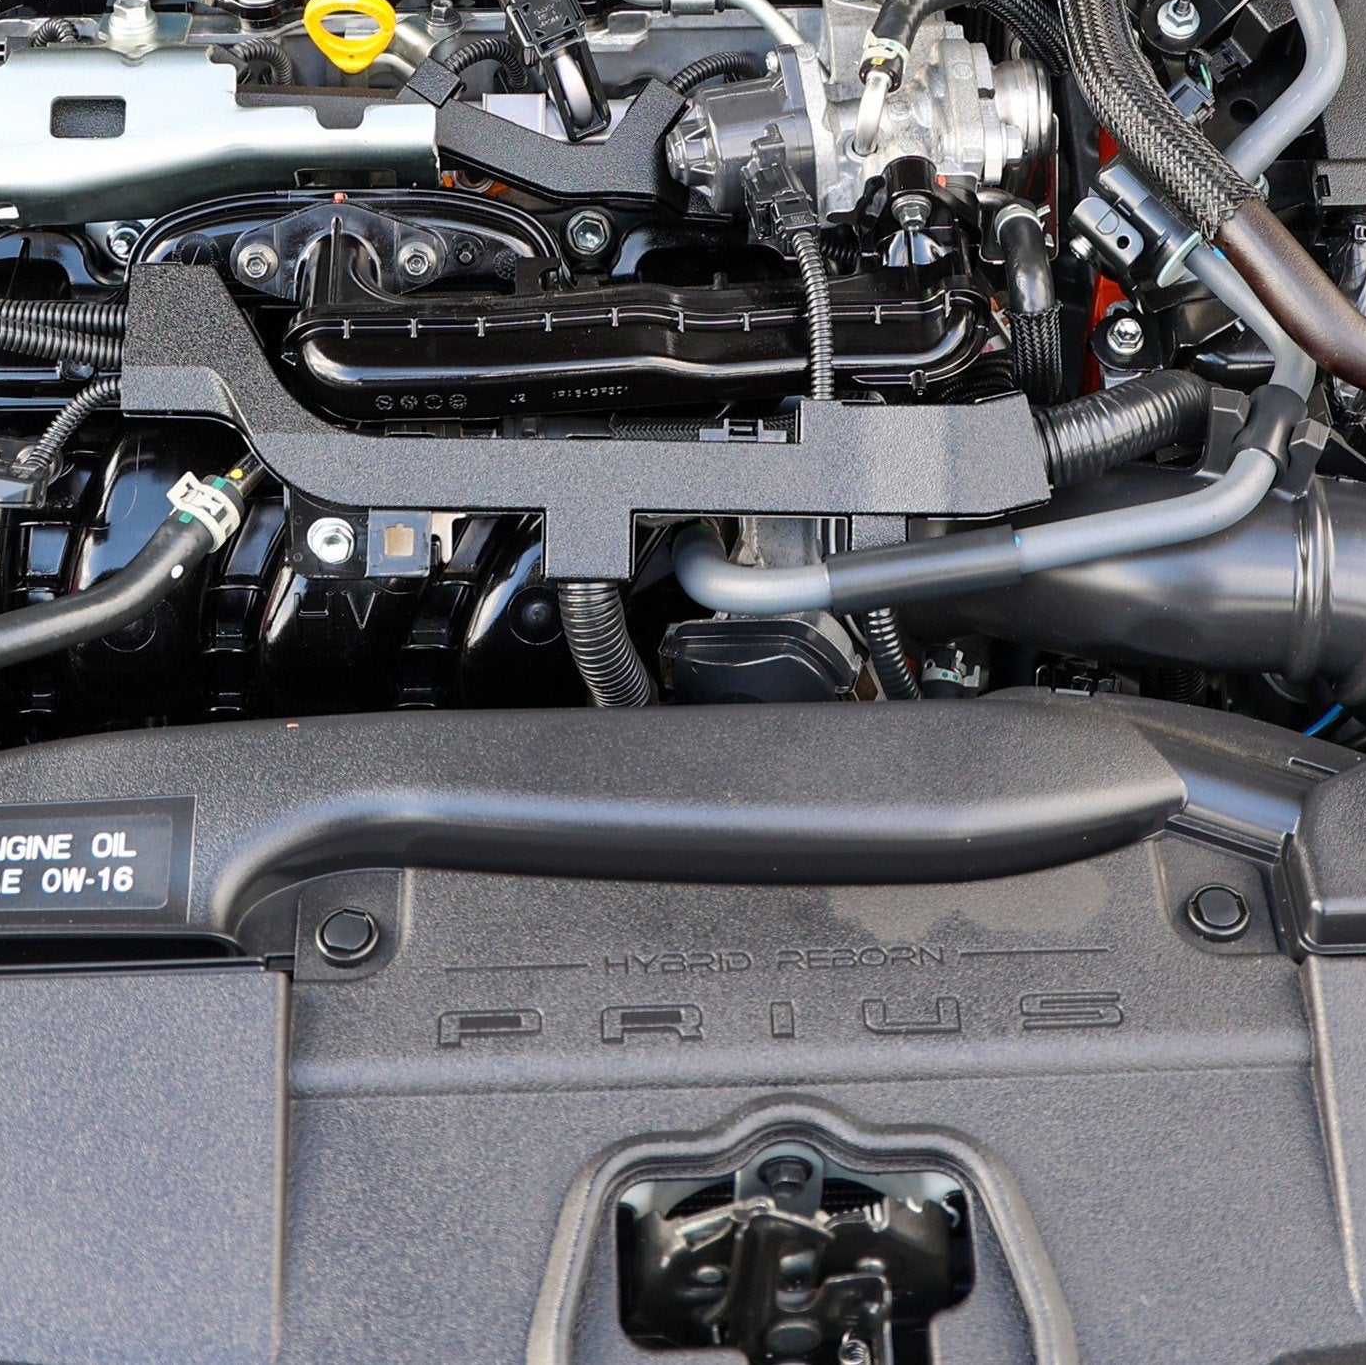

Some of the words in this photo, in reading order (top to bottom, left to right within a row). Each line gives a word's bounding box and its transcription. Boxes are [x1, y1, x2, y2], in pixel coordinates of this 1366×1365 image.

[91, 831, 137, 858] OIL
[41, 865, 134, 894] 0W-16
[602, 951, 752, 976] HYBRID
[777, 945, 946, 971] REBORN
[438, 990, 1124, 1047] PRIUS
